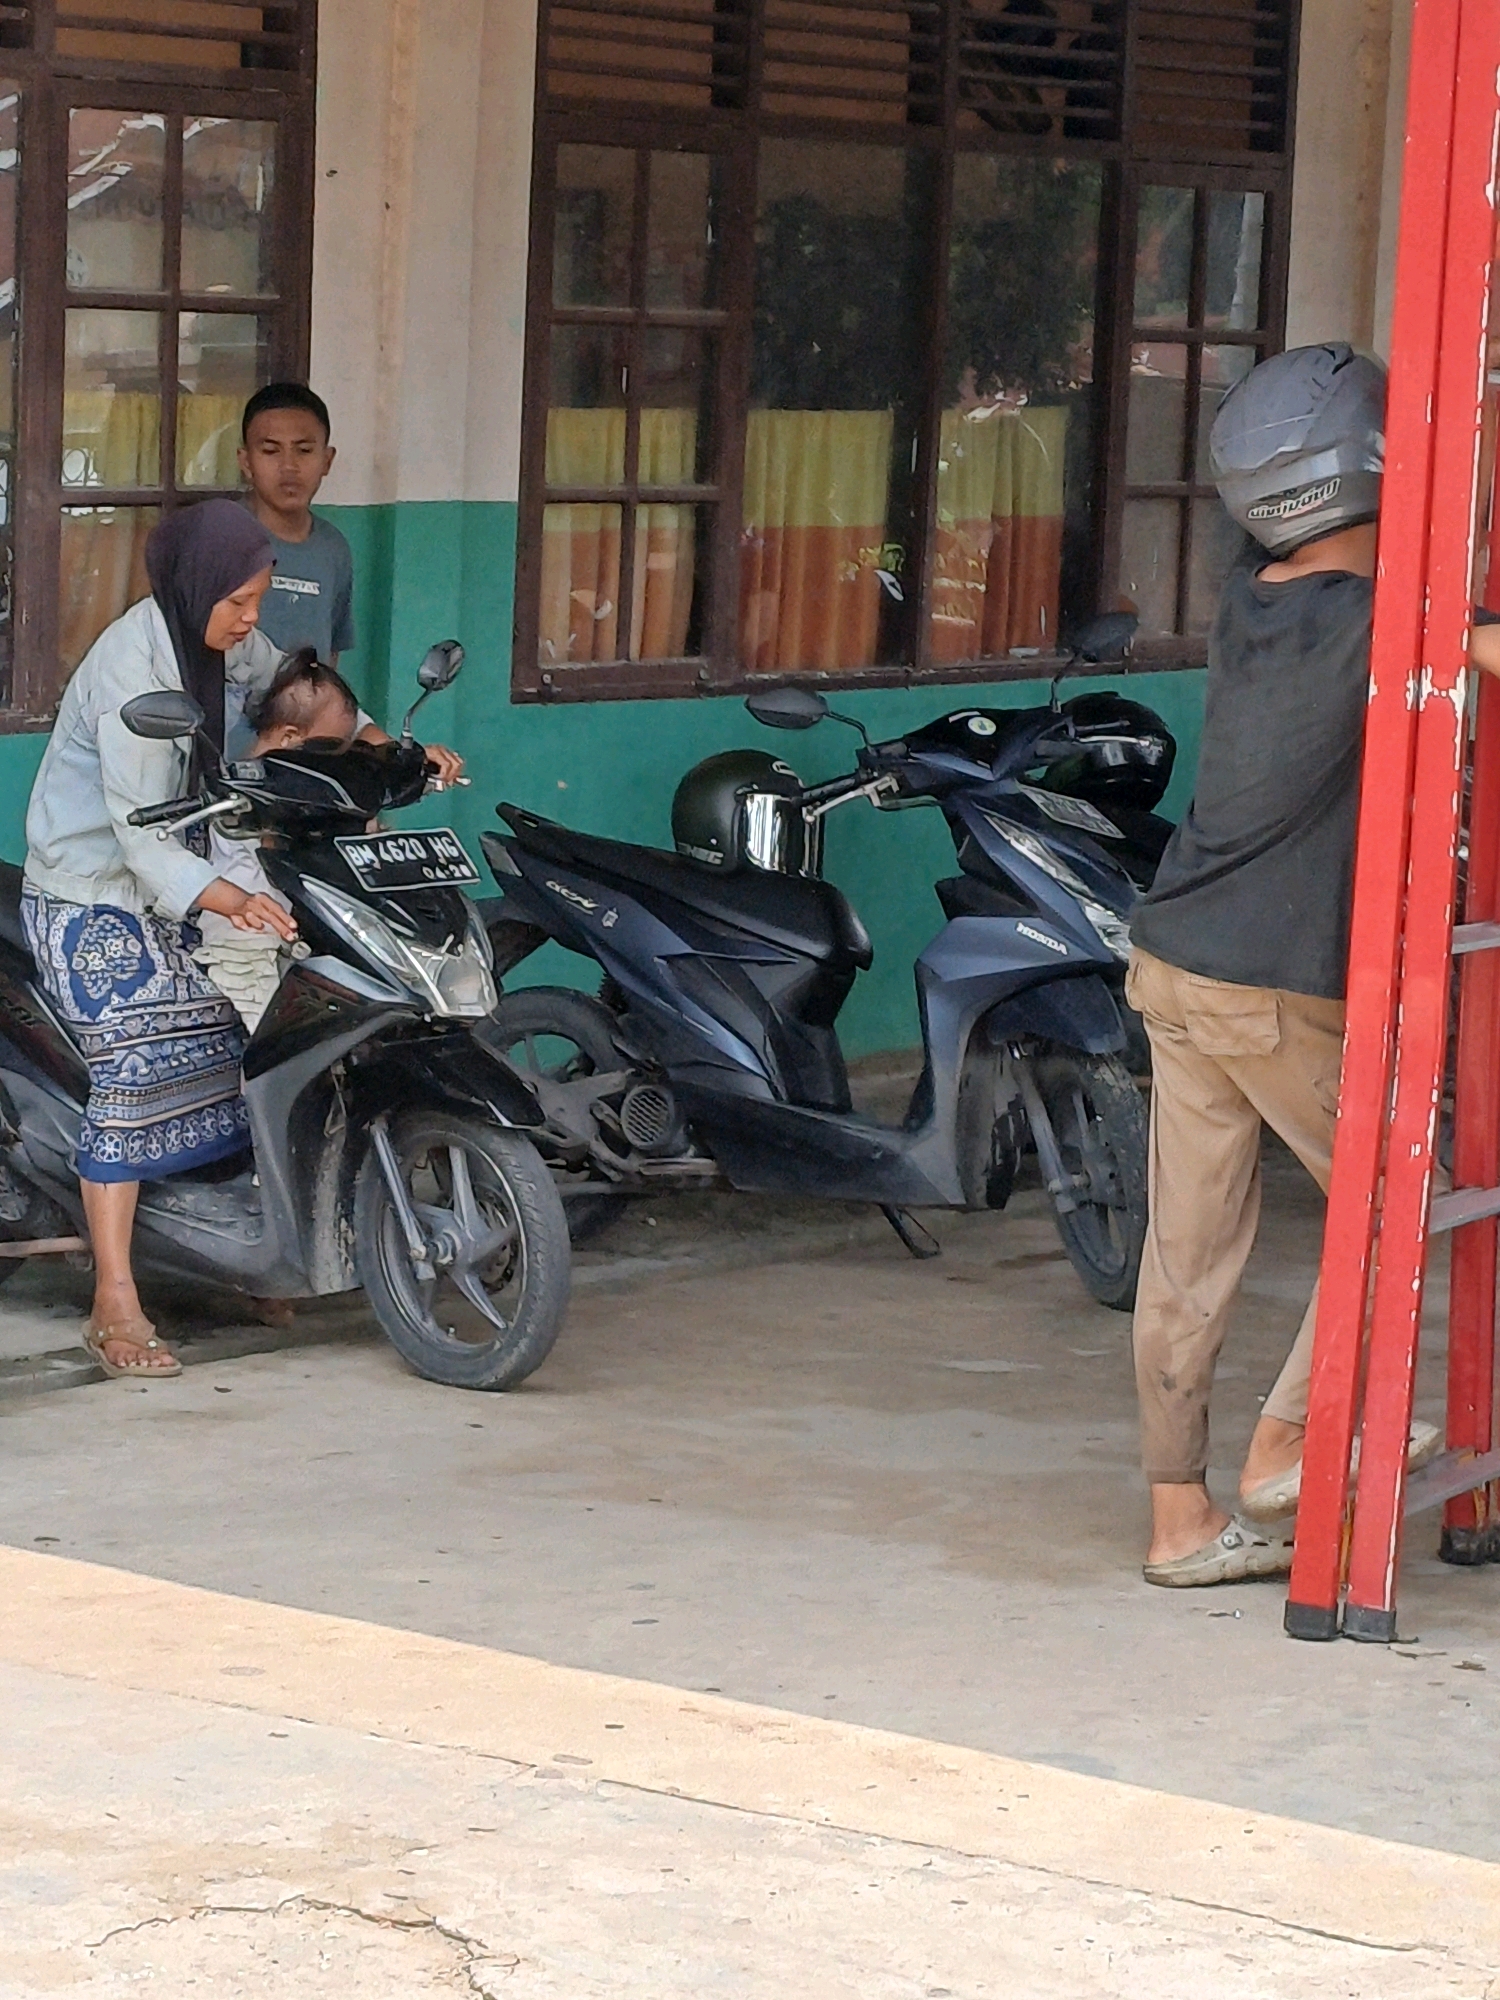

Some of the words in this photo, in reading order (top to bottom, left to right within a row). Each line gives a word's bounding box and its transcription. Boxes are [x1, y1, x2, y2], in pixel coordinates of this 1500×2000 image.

[345, 844, 382, 870] BM
[378, 837, 428, 863] 4620
[1016, 921, 1068, 956] HONDA
